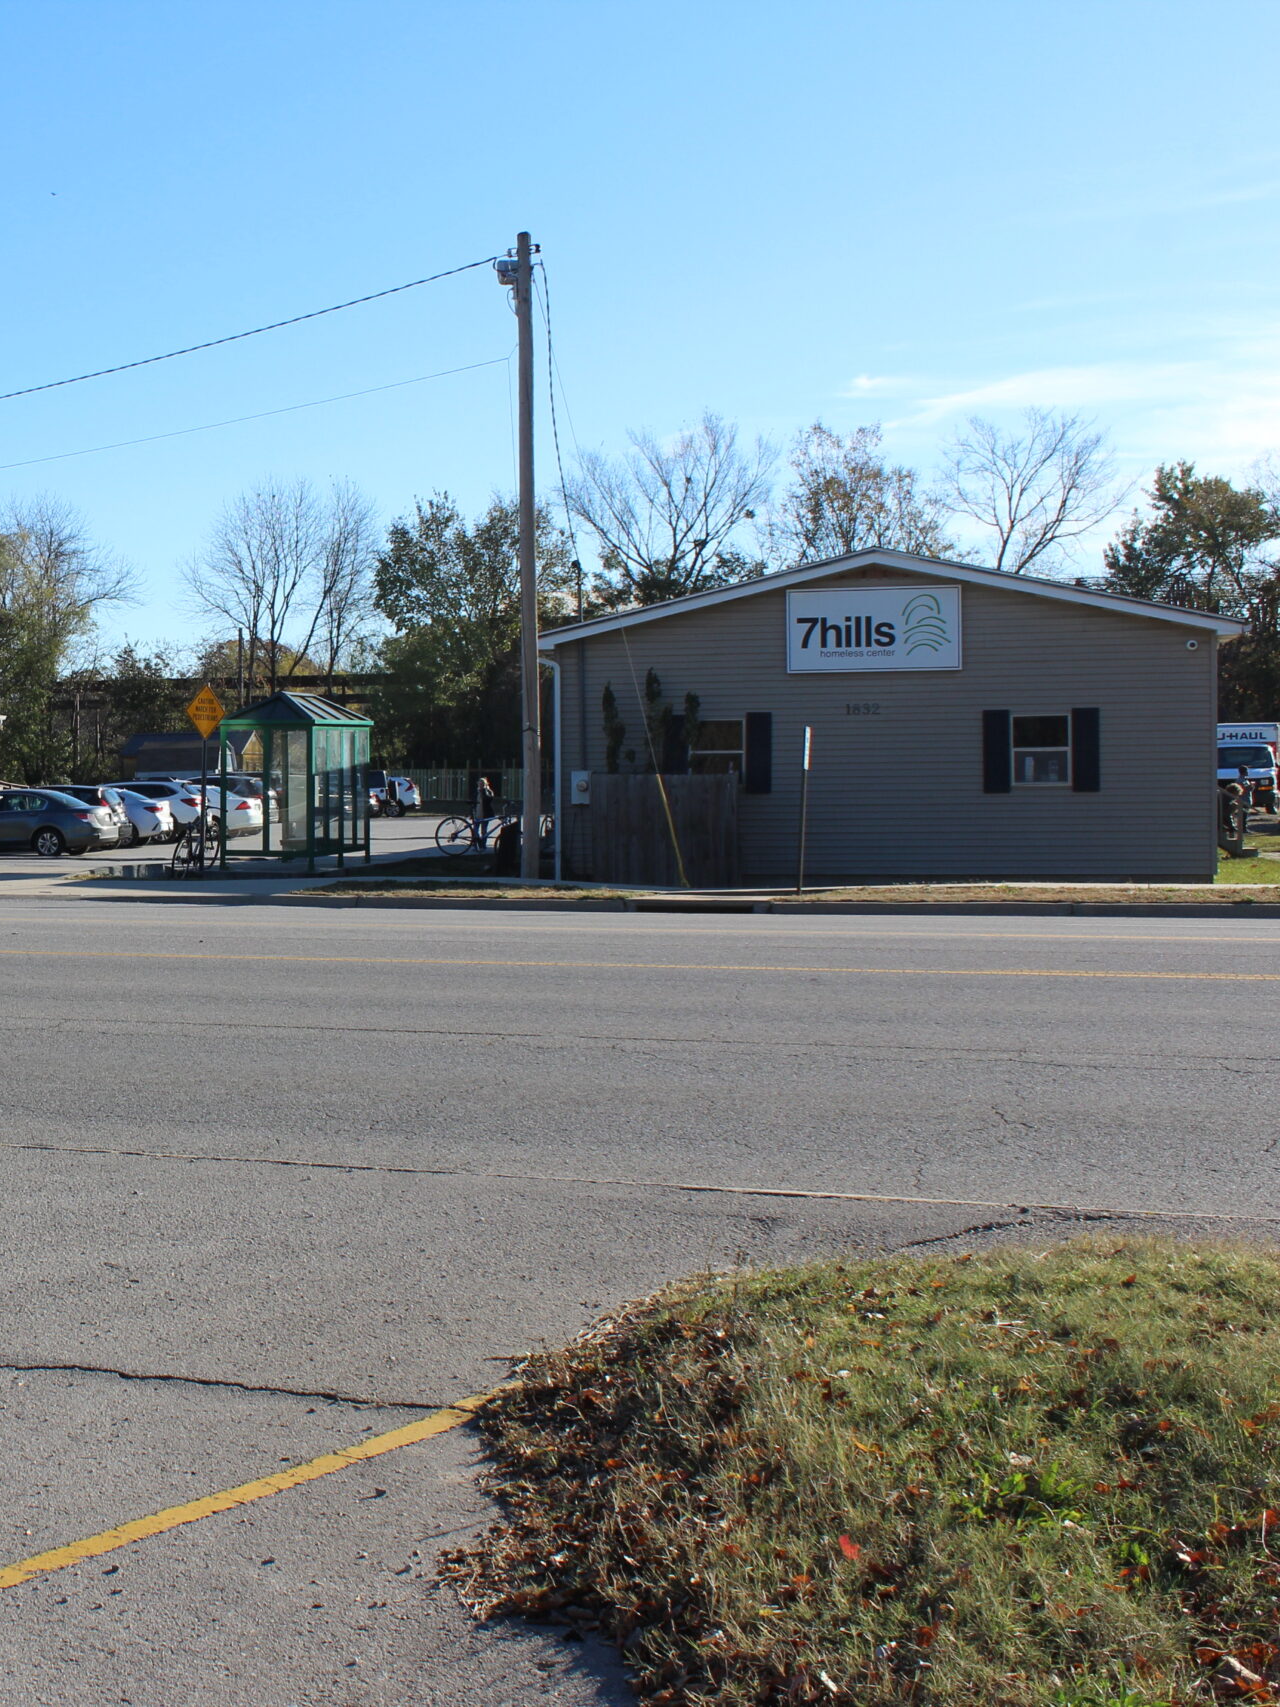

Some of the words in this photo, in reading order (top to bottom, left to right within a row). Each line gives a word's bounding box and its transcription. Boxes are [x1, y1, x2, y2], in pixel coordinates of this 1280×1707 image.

[796, 616, 896, 649] 7hills
[820, 649, 864, 658] homeless
[866, 648, 896, 657] center
[845, 703, 880, 716] 1832
